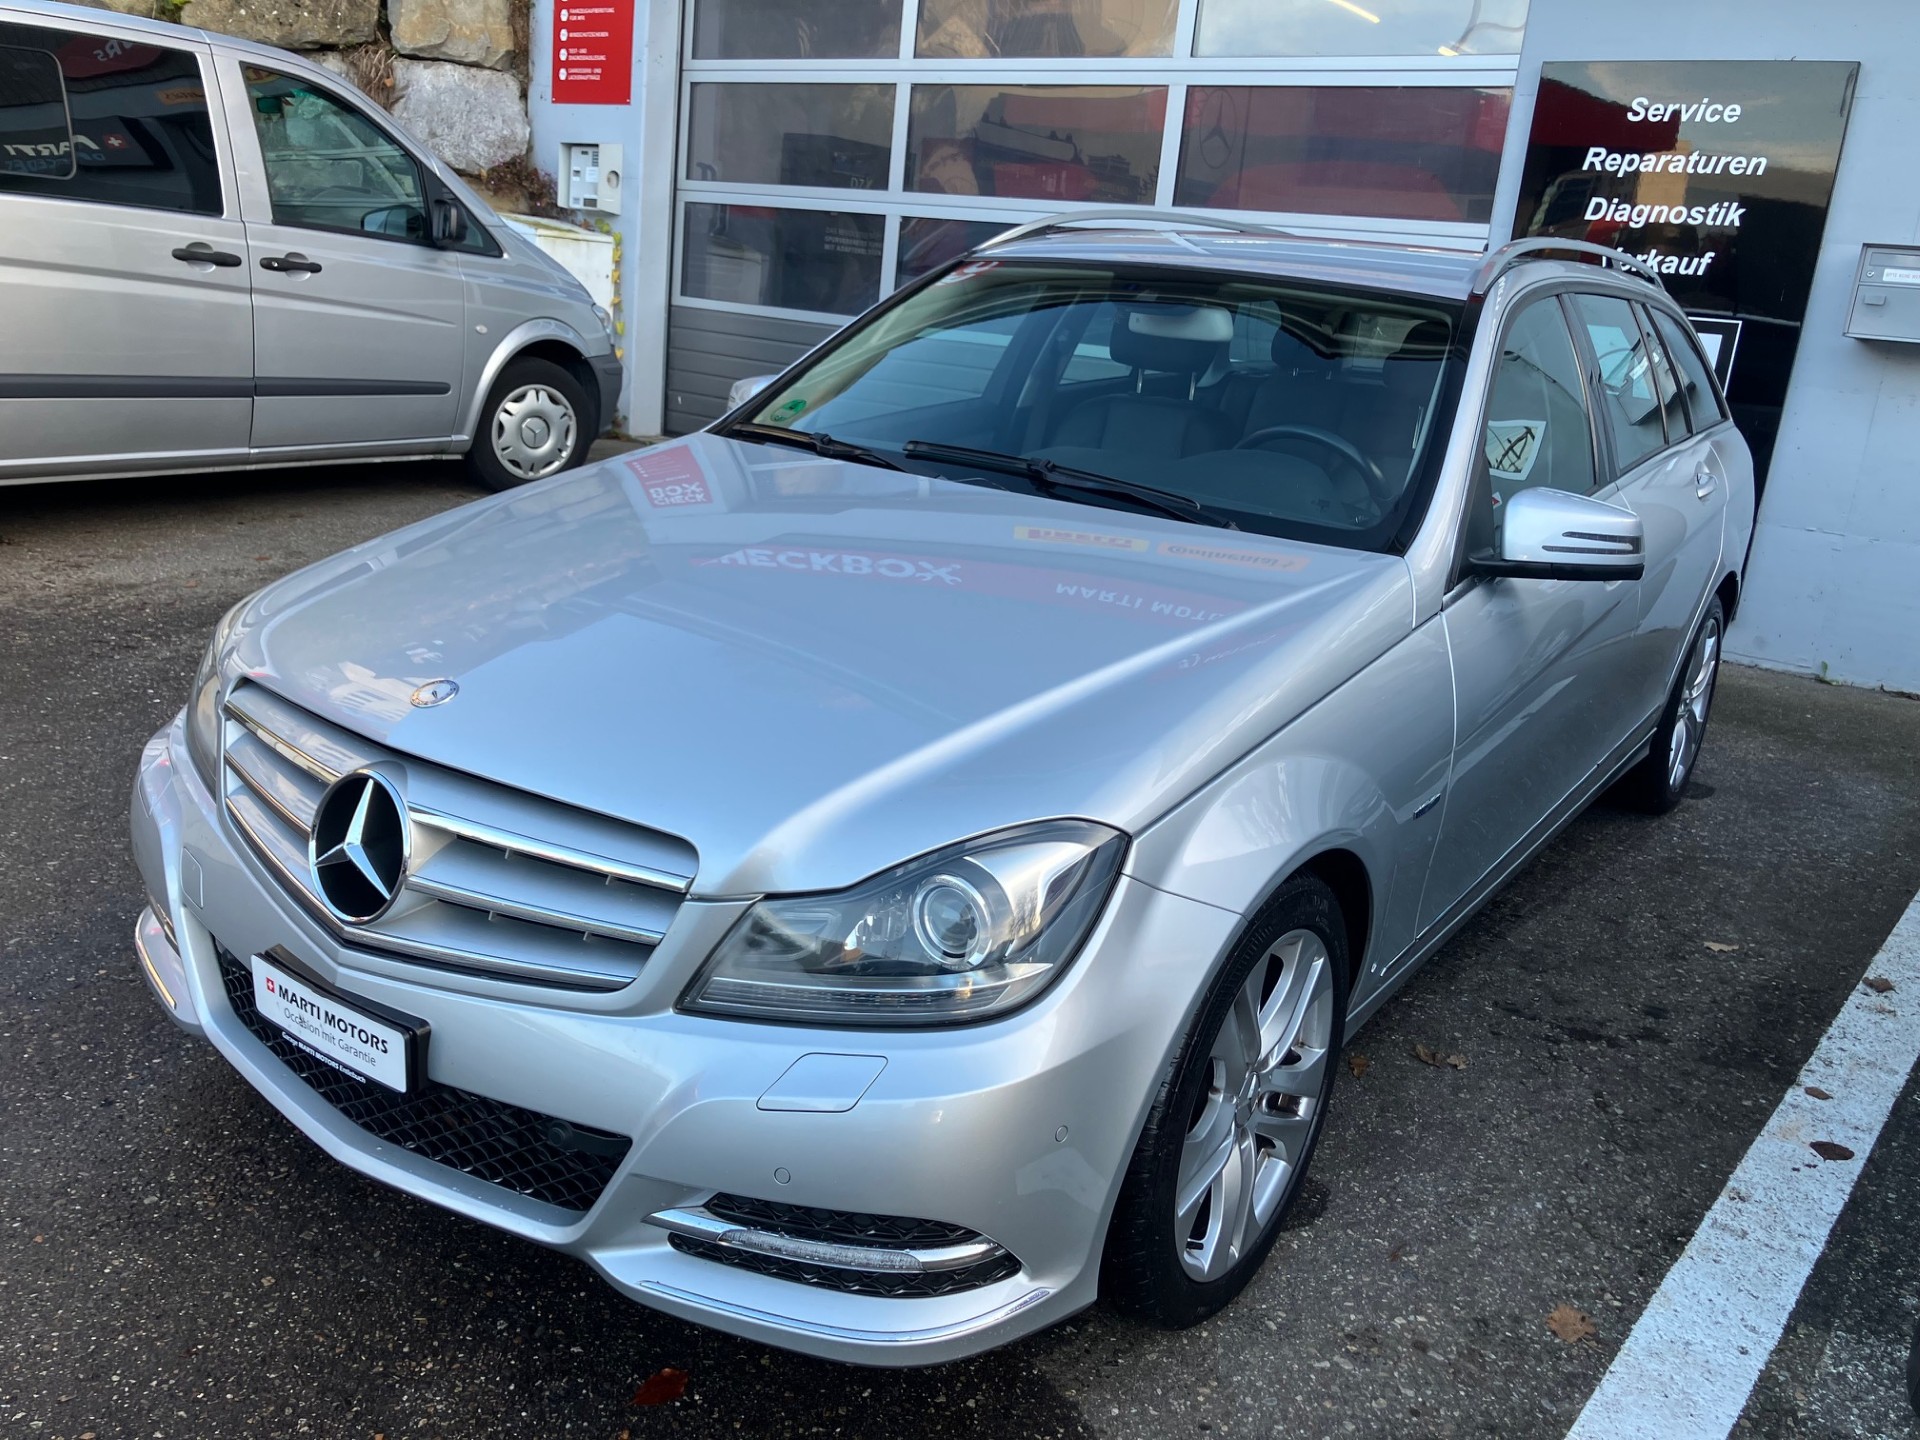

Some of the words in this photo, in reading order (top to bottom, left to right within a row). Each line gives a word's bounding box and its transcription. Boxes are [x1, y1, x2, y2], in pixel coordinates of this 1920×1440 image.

[1627, 97, 1741, 123] Service
[1582, 147, 1767, 177] Reparaturen
[1584, 196, 1746, 229] Diagnostik
[278, 984, 321, 1020] MARTI
[324, 1009, 389, 1054] MOTORS
[321, 1030, 337, 1046] mit
[337, 1038, 376, 1067] Garantie
